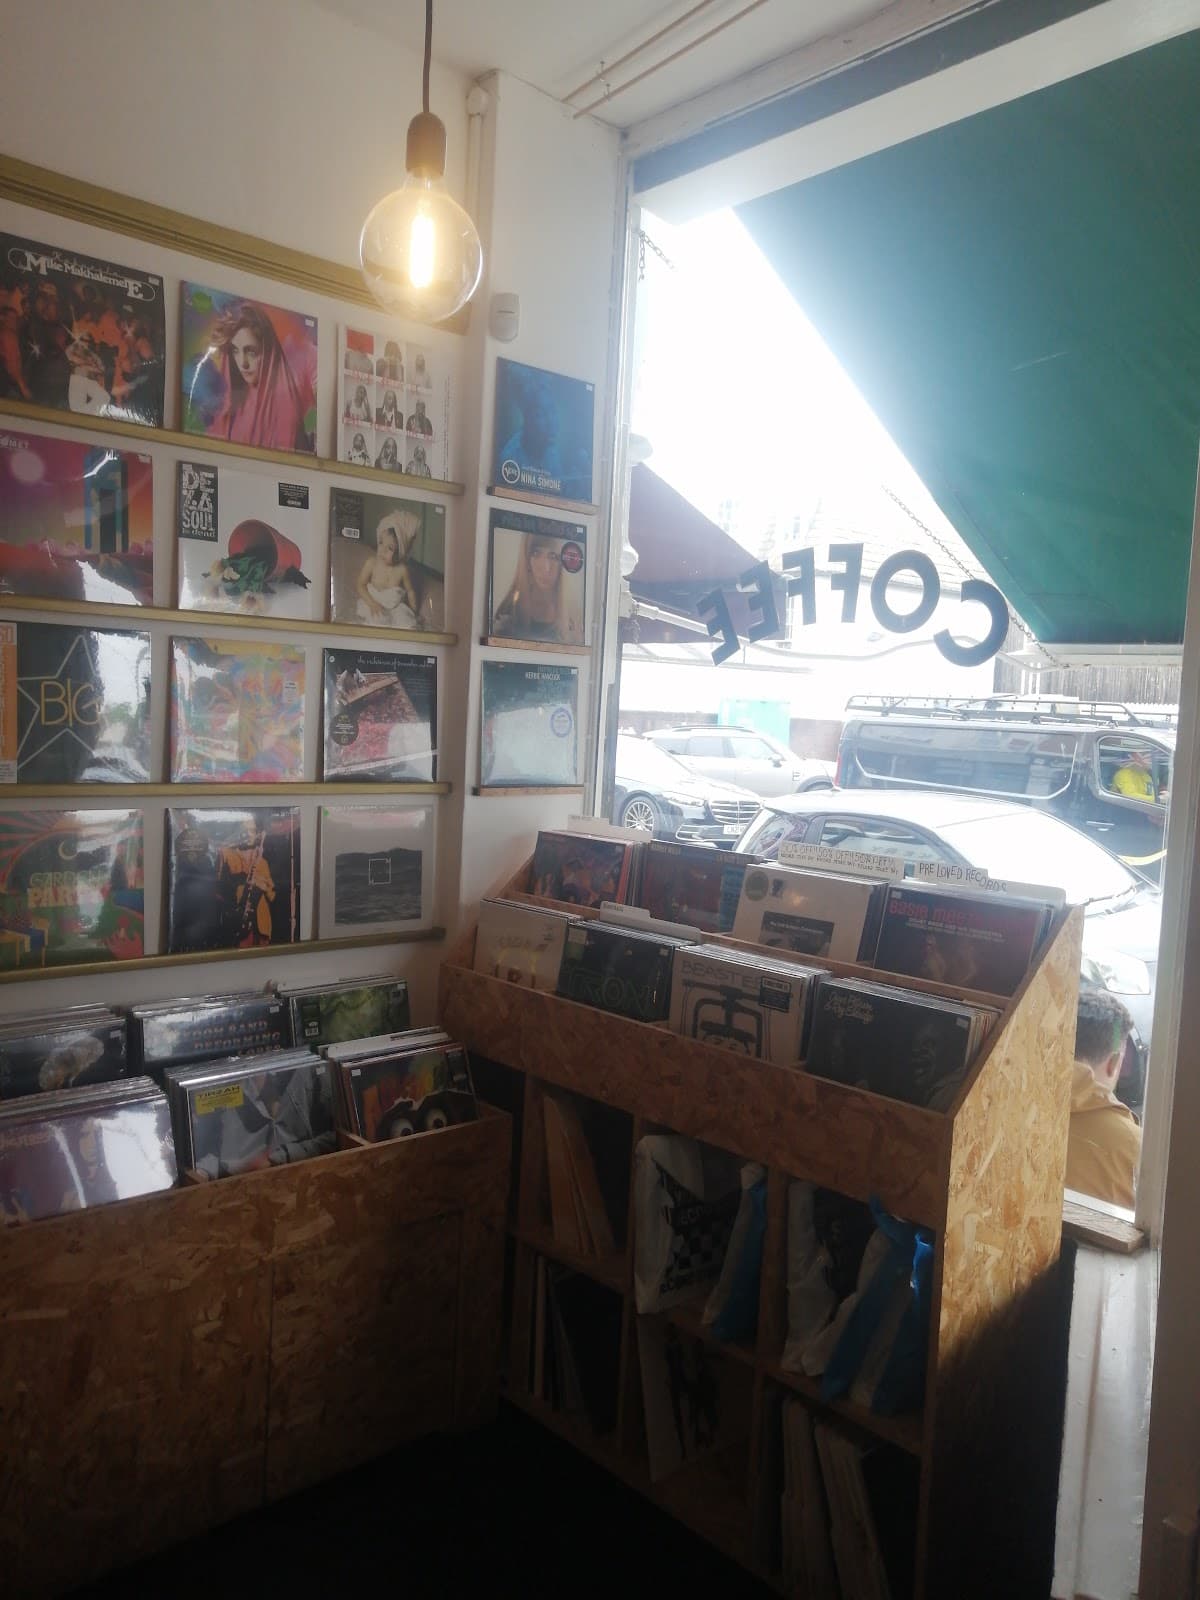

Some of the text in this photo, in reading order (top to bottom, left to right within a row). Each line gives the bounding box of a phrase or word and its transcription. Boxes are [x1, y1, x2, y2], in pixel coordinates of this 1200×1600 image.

[182, 470, 215, 493] DE
[521, 471, 561, 489] NINA SIMONE
[182, 508, 214, 531] SOUL
[40, 679, 101, 728] BIG
[919, 862, 1008, 892] PRE LOVED RECORDS
